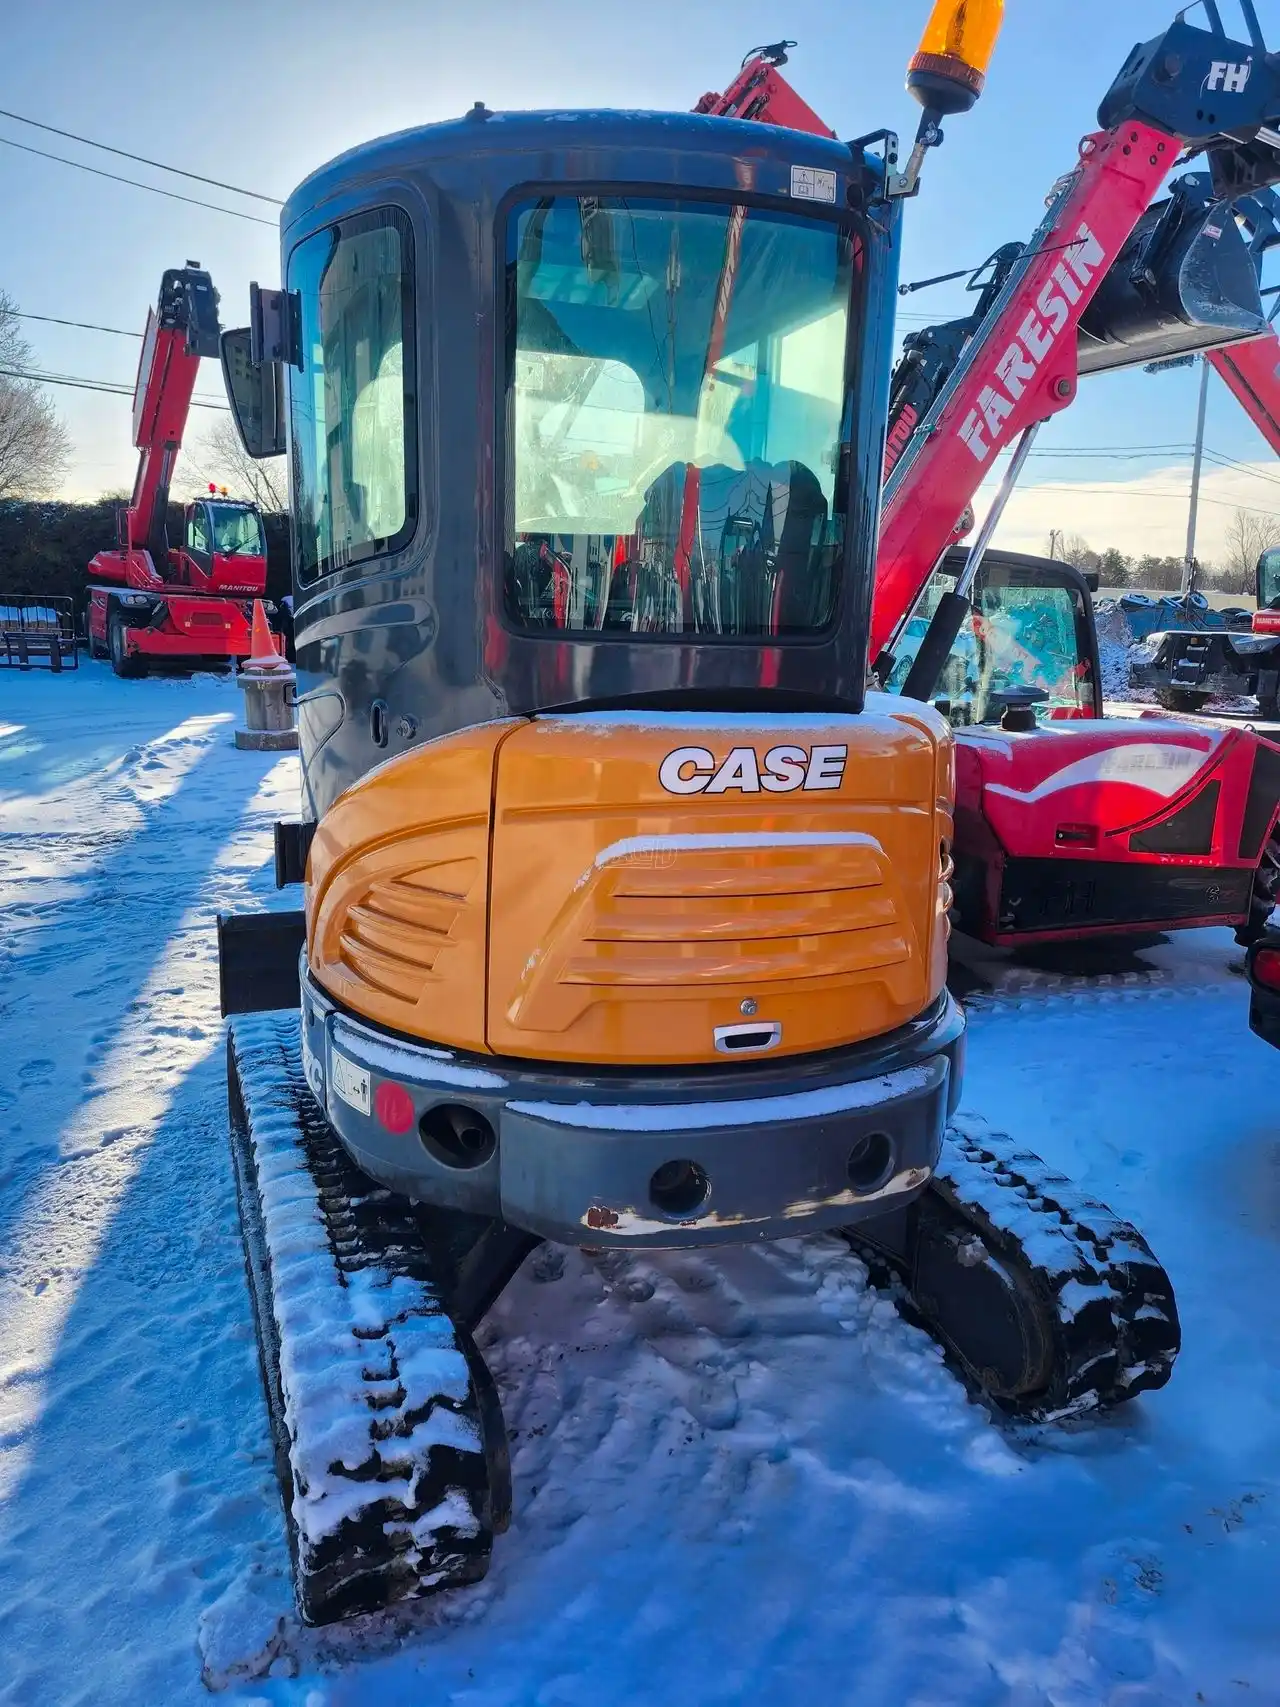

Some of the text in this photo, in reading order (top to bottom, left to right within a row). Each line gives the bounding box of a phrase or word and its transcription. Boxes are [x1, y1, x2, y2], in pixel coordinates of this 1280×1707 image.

[1207, 61, 1249, 93] FH
[957, 222, 1105, 462] FARESIN
[882, 404, 918, 482] NITOU
[218, 584, 258, 592] MANITOU
[658, 744, 848, 795] CASE
